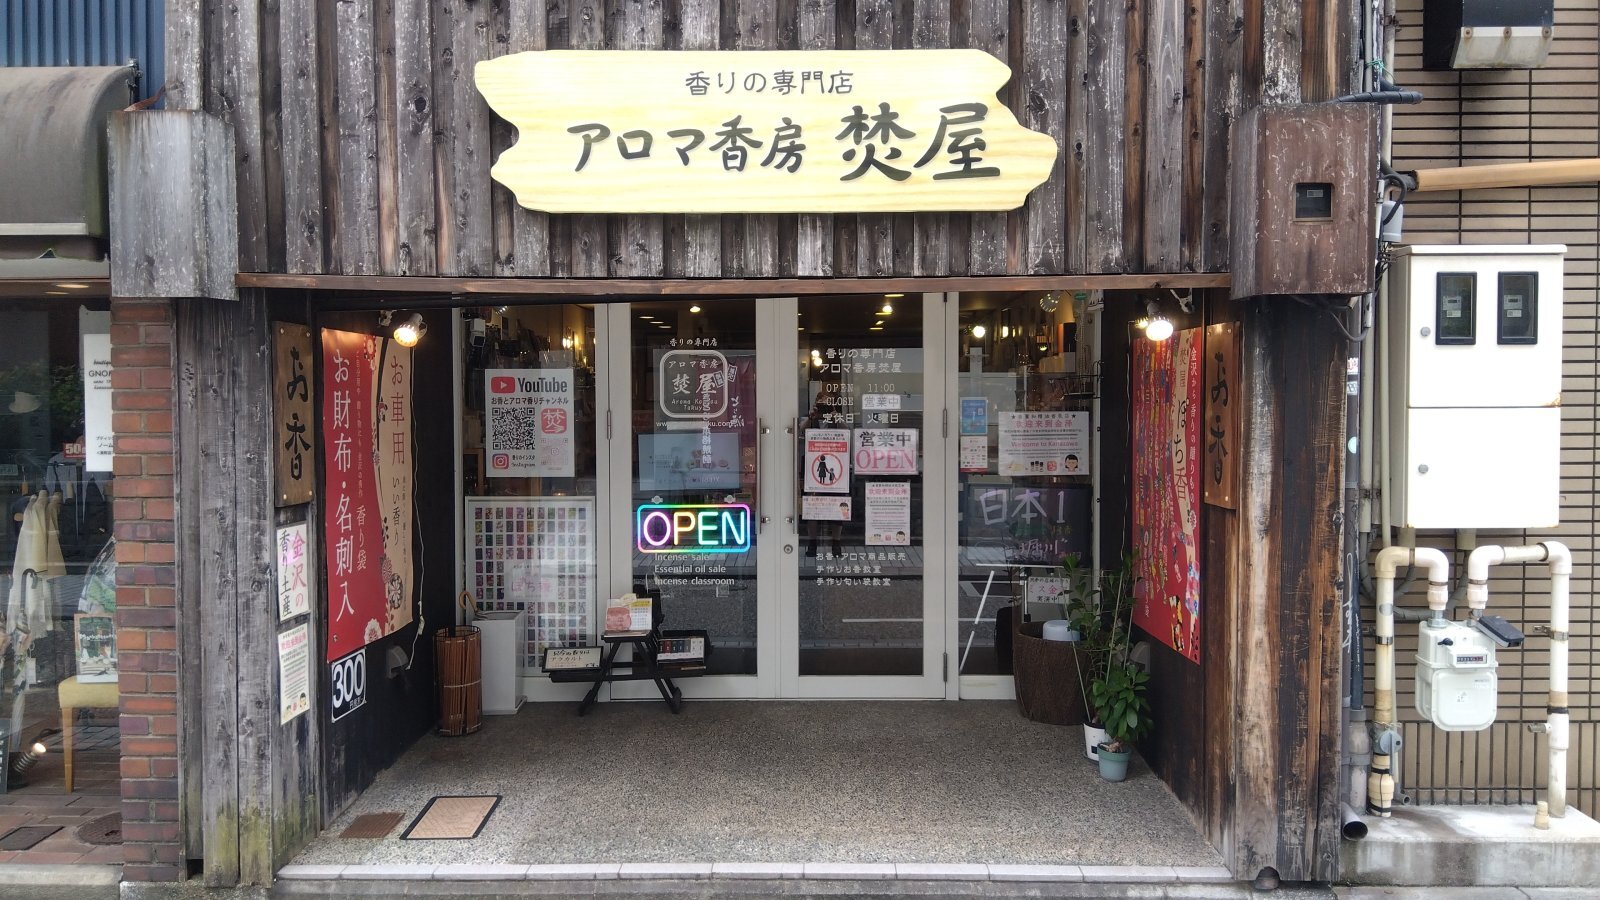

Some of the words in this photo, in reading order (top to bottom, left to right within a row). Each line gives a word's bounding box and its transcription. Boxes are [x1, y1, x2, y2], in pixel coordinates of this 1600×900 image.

[684, 70, 854, 96] 香りの専門店
[566, 113, 807, 174] アロマ香房
[834, 102, 1001, 183] 焚屋
[669, 338, 718, 347] 香りの専門店
[825, 348, 897, 359] 香りの専門店
[668, 359, 719, 369] アロマ香房
[819, 362, 902, 373] アロマ香房焚屋
[517, 377, 568, 393] YouTube
[671, 373, 717, 395] 焚屋
[826, 383, 854, 392] OPEN
[868, 383, 895, 392] 11:00
[491, 396, 569, 405] お香とアロマ香りチャンネル
[826, 396, 854, 406] CLOSE
[284, 346, 312, 481] お香
[390, 355, 405, 466] お車用
[822, 413, 854, 424] 定休日
[1208, 351, 1229, 485] お香
[1188, 346, 1198, 504] 金沢から香りの贈りもの
[859, 431, 912, 448] 営業中
[855, 450, 915, 469] OPEN
[333, 349, 355, 622] お財布・名刺入
[643, 511, 745, 546] OPEN
[356, 505, 367, 571] 香り袋
[654, 553, 688, 561] Incense
[691, 553, 710, 561] sale
[816, 552, 907, 561] お香・アロマ商品販売
[654, 565, 692, 573] Essential
[695, 565, 706, 573] oil
[708, 565, 726, 573] sale
[816, 565, 882, 574] 手作りお香教室
[654, 577, 688, 585] Incense
[691, 576, 735, 585] classroom
[816, 577, 891, 586] 手作り匂い袋教室
[333, 653, 364, 708] 300
